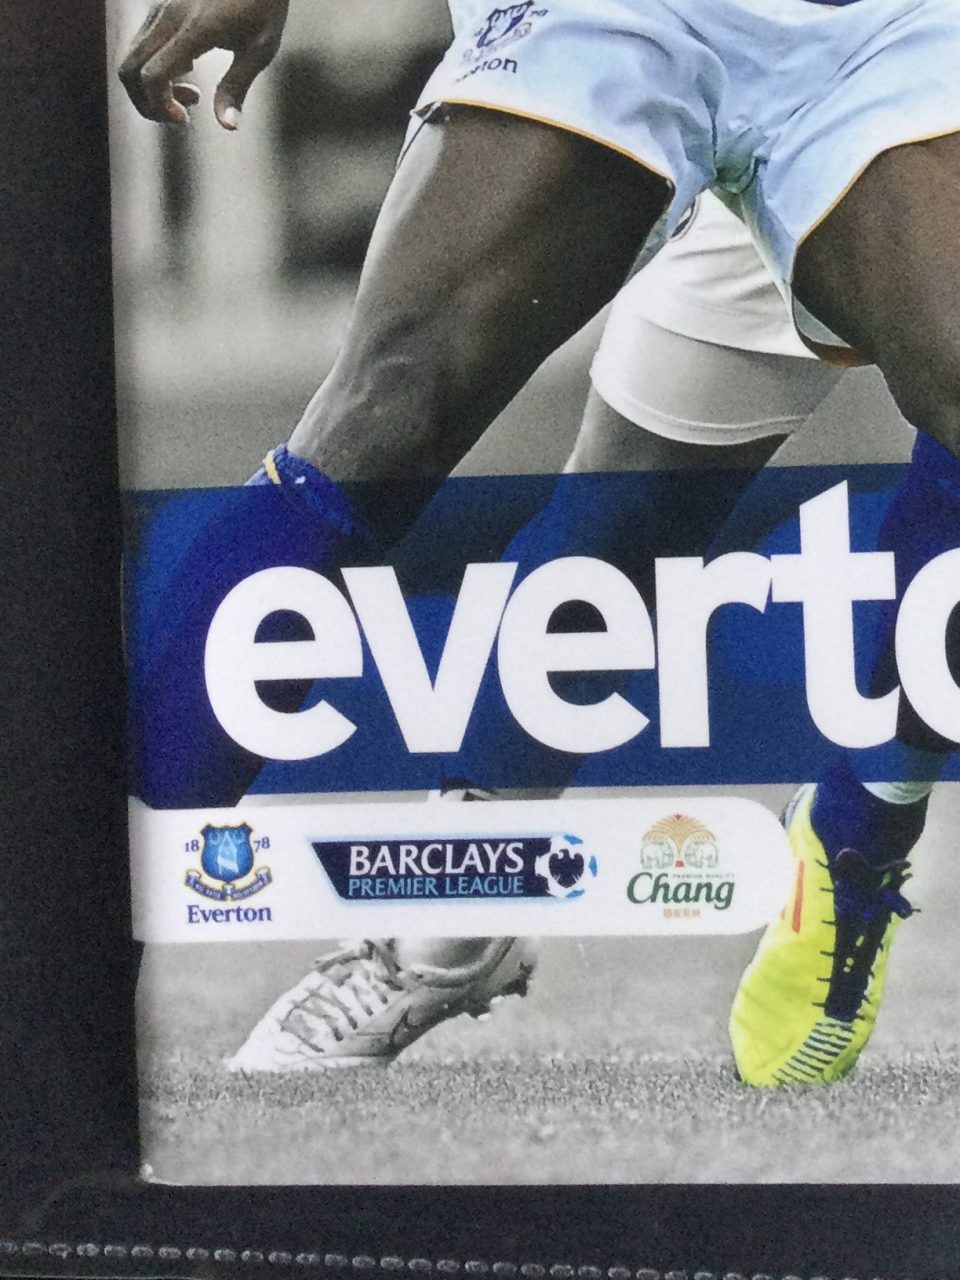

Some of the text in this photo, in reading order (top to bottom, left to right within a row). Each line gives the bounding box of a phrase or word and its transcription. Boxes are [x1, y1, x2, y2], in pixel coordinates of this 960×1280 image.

[185, 836, 270, 852] 18 78
[350, 842, 524, 876] BARCLAYS
[348, 876, 524, 897] PREMIER LEAGUE
[627, 872, 735, 910] Chang
[187, 904, 272, 924] Everton
